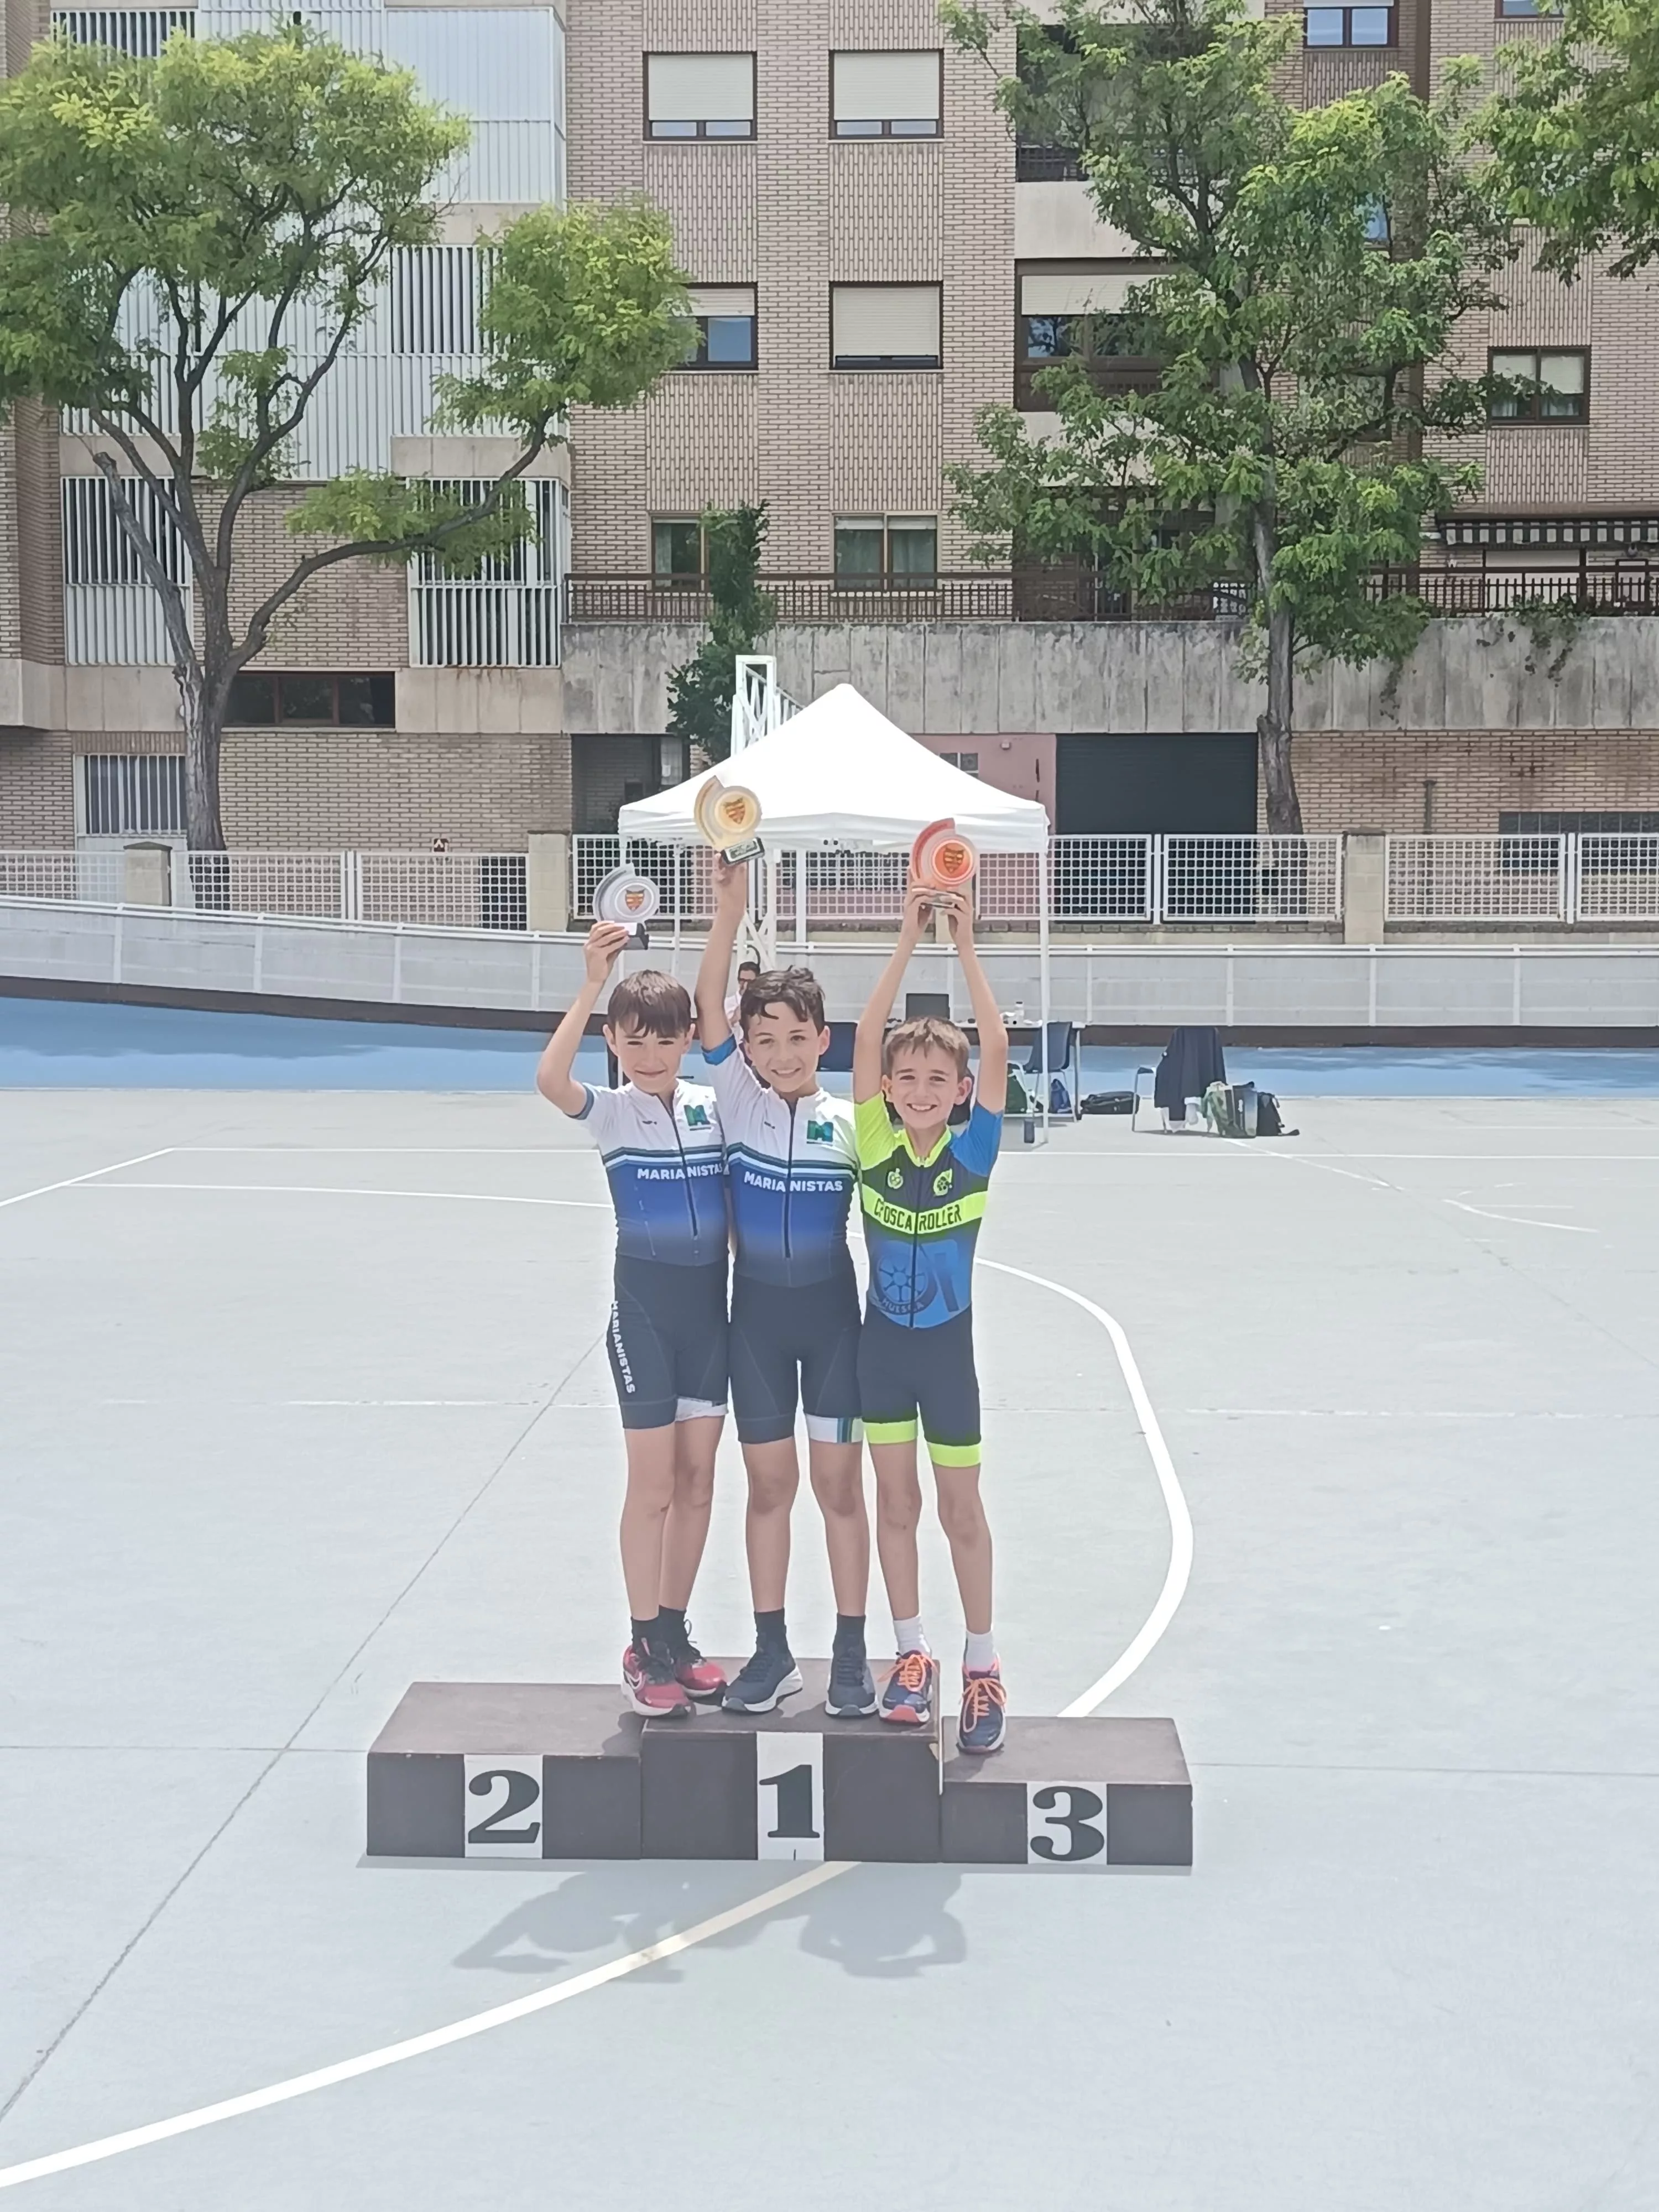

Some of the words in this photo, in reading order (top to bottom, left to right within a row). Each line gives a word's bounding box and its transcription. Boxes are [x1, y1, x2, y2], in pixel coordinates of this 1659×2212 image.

[637, 1162, 723, 1180] MARIANISTAS
[744, 1171, 843, 1192] MARIANISTAS
[919, 1204, 962, 1231] ROLLER
[612, 1301, 636, 1393] MARIANISTAS
[468, 1770, 540, 1844] 2
[759, 1764, 820, 1838] 1
[1030, 1786, 1104, 1861] 3
